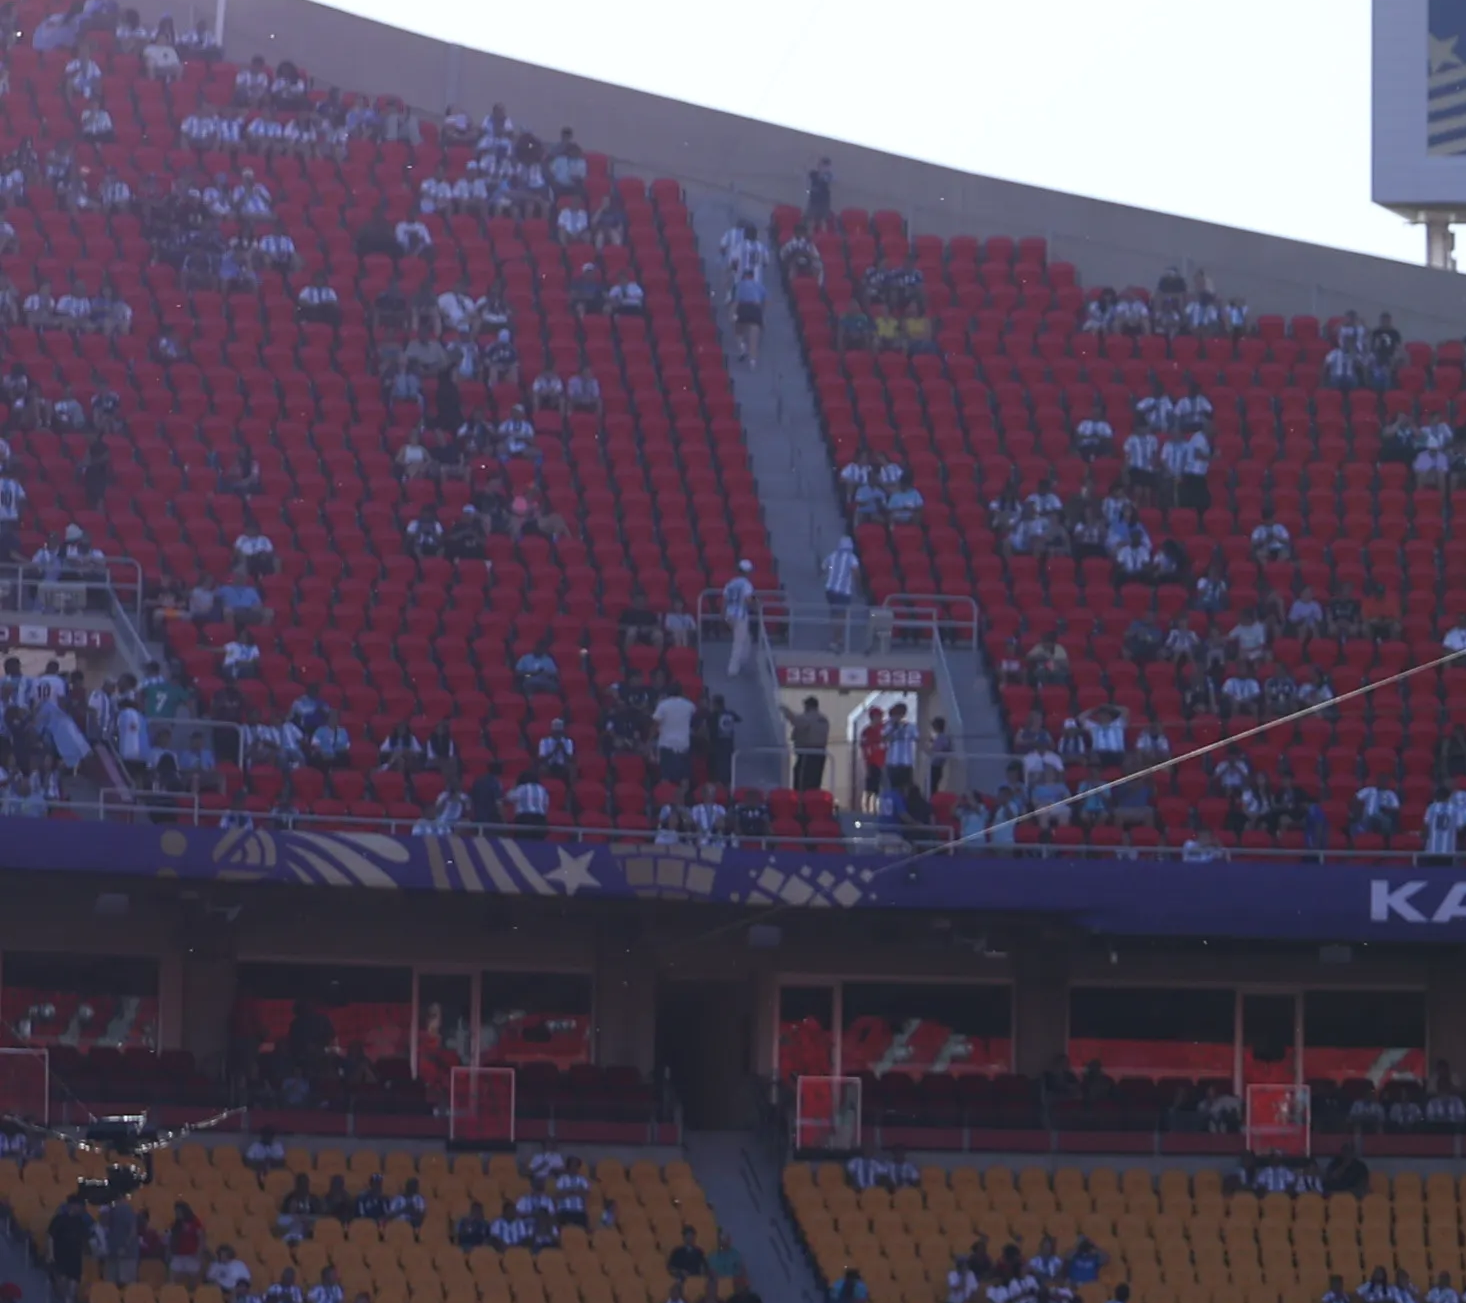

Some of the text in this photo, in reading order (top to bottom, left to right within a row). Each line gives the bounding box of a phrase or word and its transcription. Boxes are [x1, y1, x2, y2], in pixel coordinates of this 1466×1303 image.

[58, 628, 101, 648] 331
[786, 667, 922, 686] 331 332
